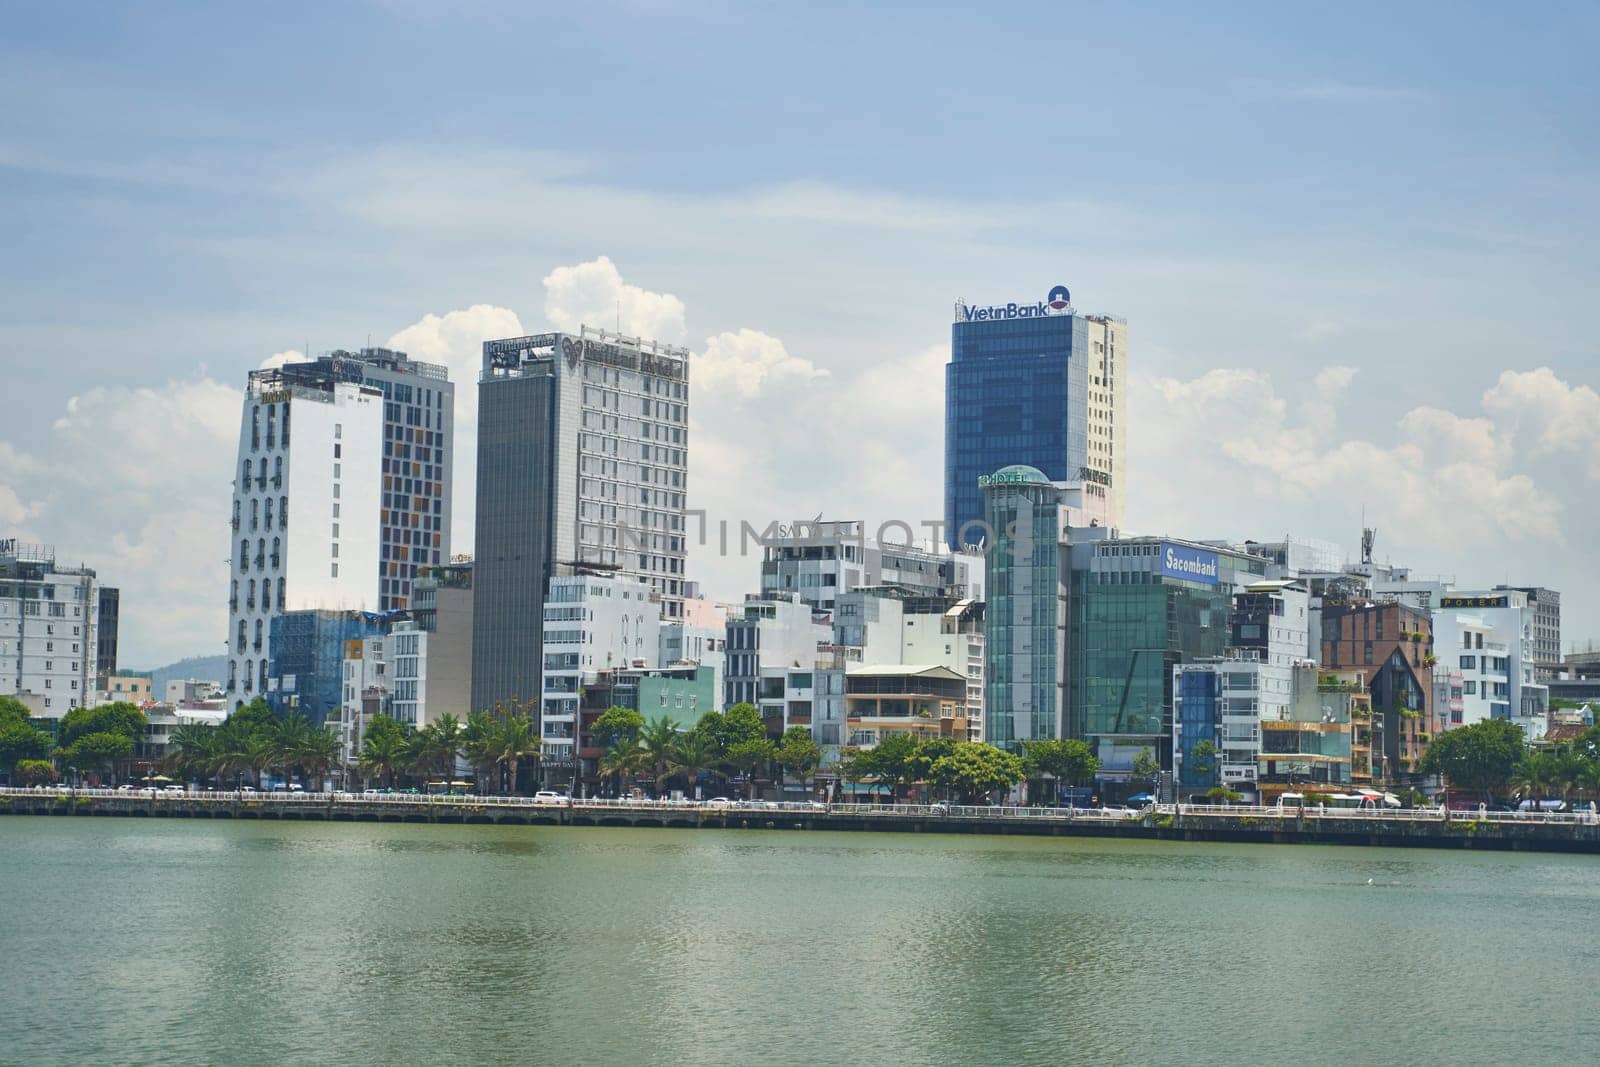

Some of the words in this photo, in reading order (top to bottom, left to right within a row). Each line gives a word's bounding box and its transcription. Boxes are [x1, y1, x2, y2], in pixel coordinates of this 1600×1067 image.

[963, 301, 1048, 321] VietinBank
[1166, 547, 1217, 577] Sacombank
[1444, 598, 1497, 607] POKER
